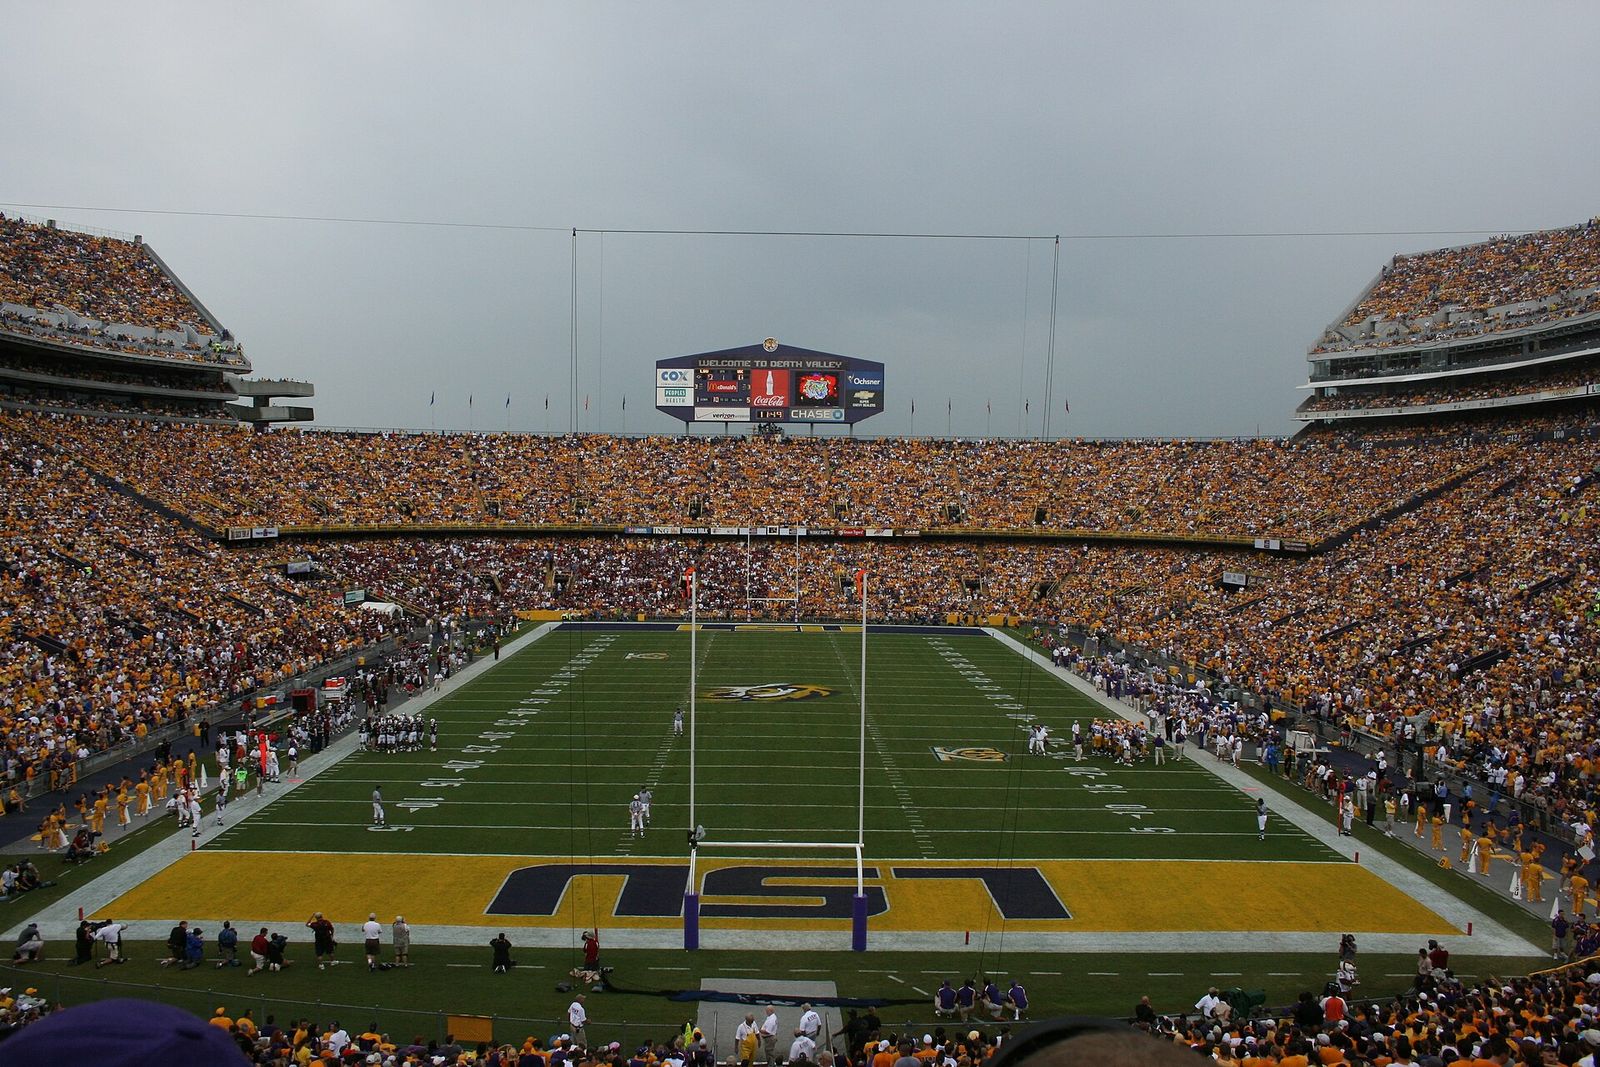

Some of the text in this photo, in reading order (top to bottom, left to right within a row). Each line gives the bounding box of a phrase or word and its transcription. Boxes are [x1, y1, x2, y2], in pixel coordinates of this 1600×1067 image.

[770, 360, 802, 368] DEATH
[661, 371, 687, 381] COX
[853, 377, 880, 385] Ochsner
[791, 410, 830, 419] CHASE
[442, 760, 485, 769] 20
[1063, 766, 1108, 776] 20
[420, 778, 465, 787] 15
[1082, 784, 1129, 793] 15
[395, 797, 445, 808] 10
[1105, 804, 1155, 815] 10
[482, 863, 1073, 920] LSU
